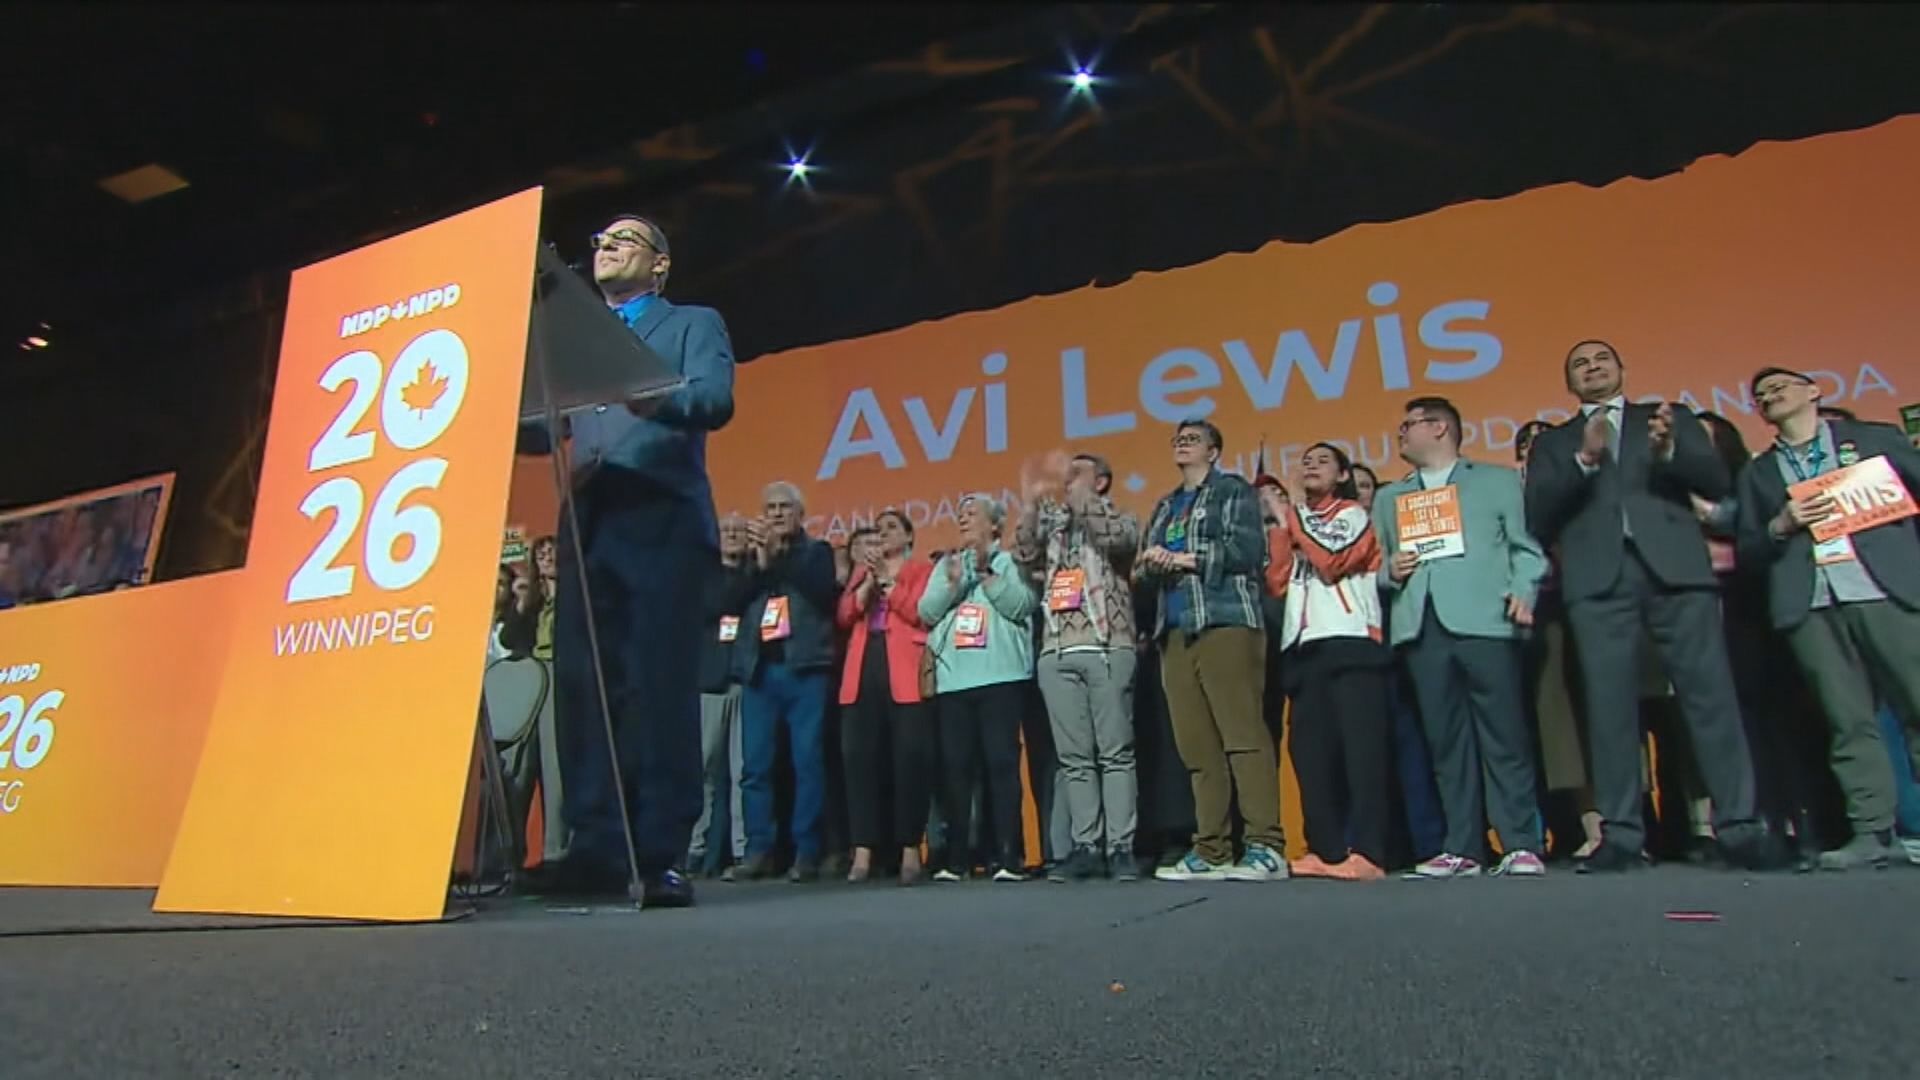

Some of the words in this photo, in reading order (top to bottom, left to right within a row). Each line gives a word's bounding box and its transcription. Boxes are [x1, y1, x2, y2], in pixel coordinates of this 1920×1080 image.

[340, 304, 391, 338] NDP
[407, 283, 461, 318] NPD
[816, 352, 1008, 481] Avi
[1060, 281, 1503, 440] Lewis
[308, 328, 470, 473] 20
[286, 456, 449, 604] 26
[275, 605, 434, 657] WINNIPEG
